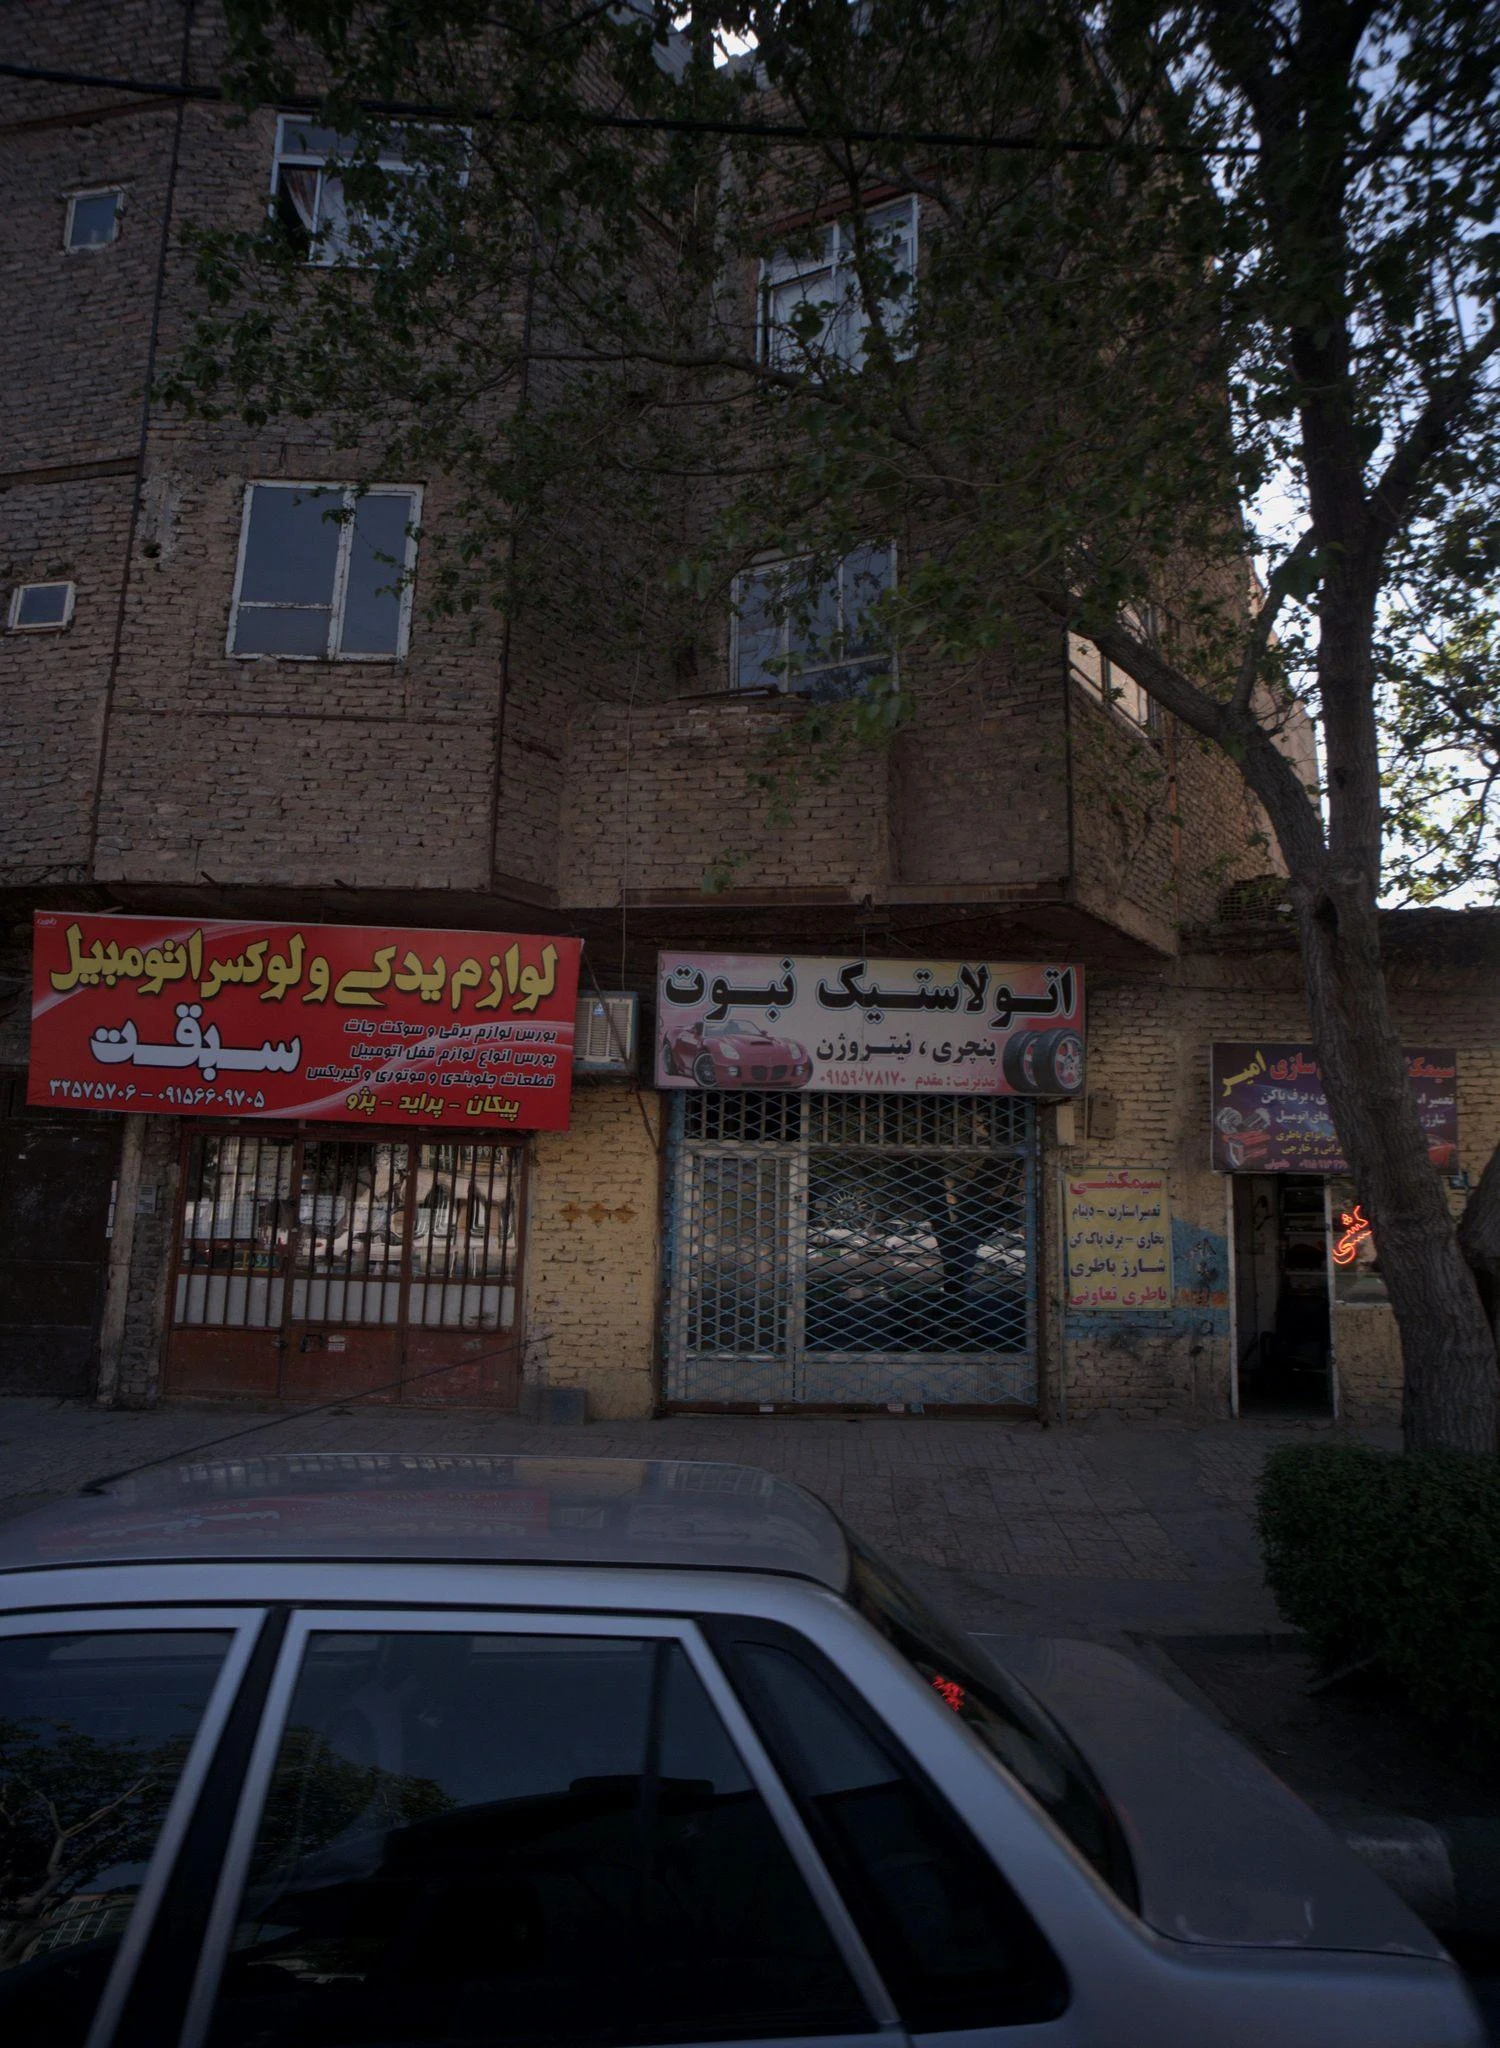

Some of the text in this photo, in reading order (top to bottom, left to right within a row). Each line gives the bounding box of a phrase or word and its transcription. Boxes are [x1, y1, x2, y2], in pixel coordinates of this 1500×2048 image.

[49, 922, 203, 996] اتومبیل
[199, 931, 307, 1001] لوکس
[301, 955, 331, 1004] و
[451, 942, 559, 1011] لوازم
[664, 957, 798, 1023] نبوت
[90, 1002, 301, 1083] سبقت
[343, 1018, 557, 1045] بورس لوازم برقی و سوکت جات
[350, 1042, 556, 1068] بورس انواع لوازم قفل اتومبیل
[815, 1032, 913, 1062] نیتروژن
[931, 1037, 997, 1066] پنچری
[362, 1068, 374, 1082] و
[374, 1067, 426, 1084] موتوری
[427, 1071, 438, 1085] و
[440, 1069, 498, 1089] جلوبندی
[500, 1071, 555, 1088] قطعات
[1222, 1049, 1318, 1097] سازی امیر
[1406, 1056, 1457, 1084] سیمک
[345, 1084, 378, 1117] پژو
[397, 1091, 446, 1119] پراید
[466, 1094, 520, 1122] پیکان
[1070, 1257, 1166, 1278] شارژ باطری
[1121, 1286, 1168, 1306] باطری
